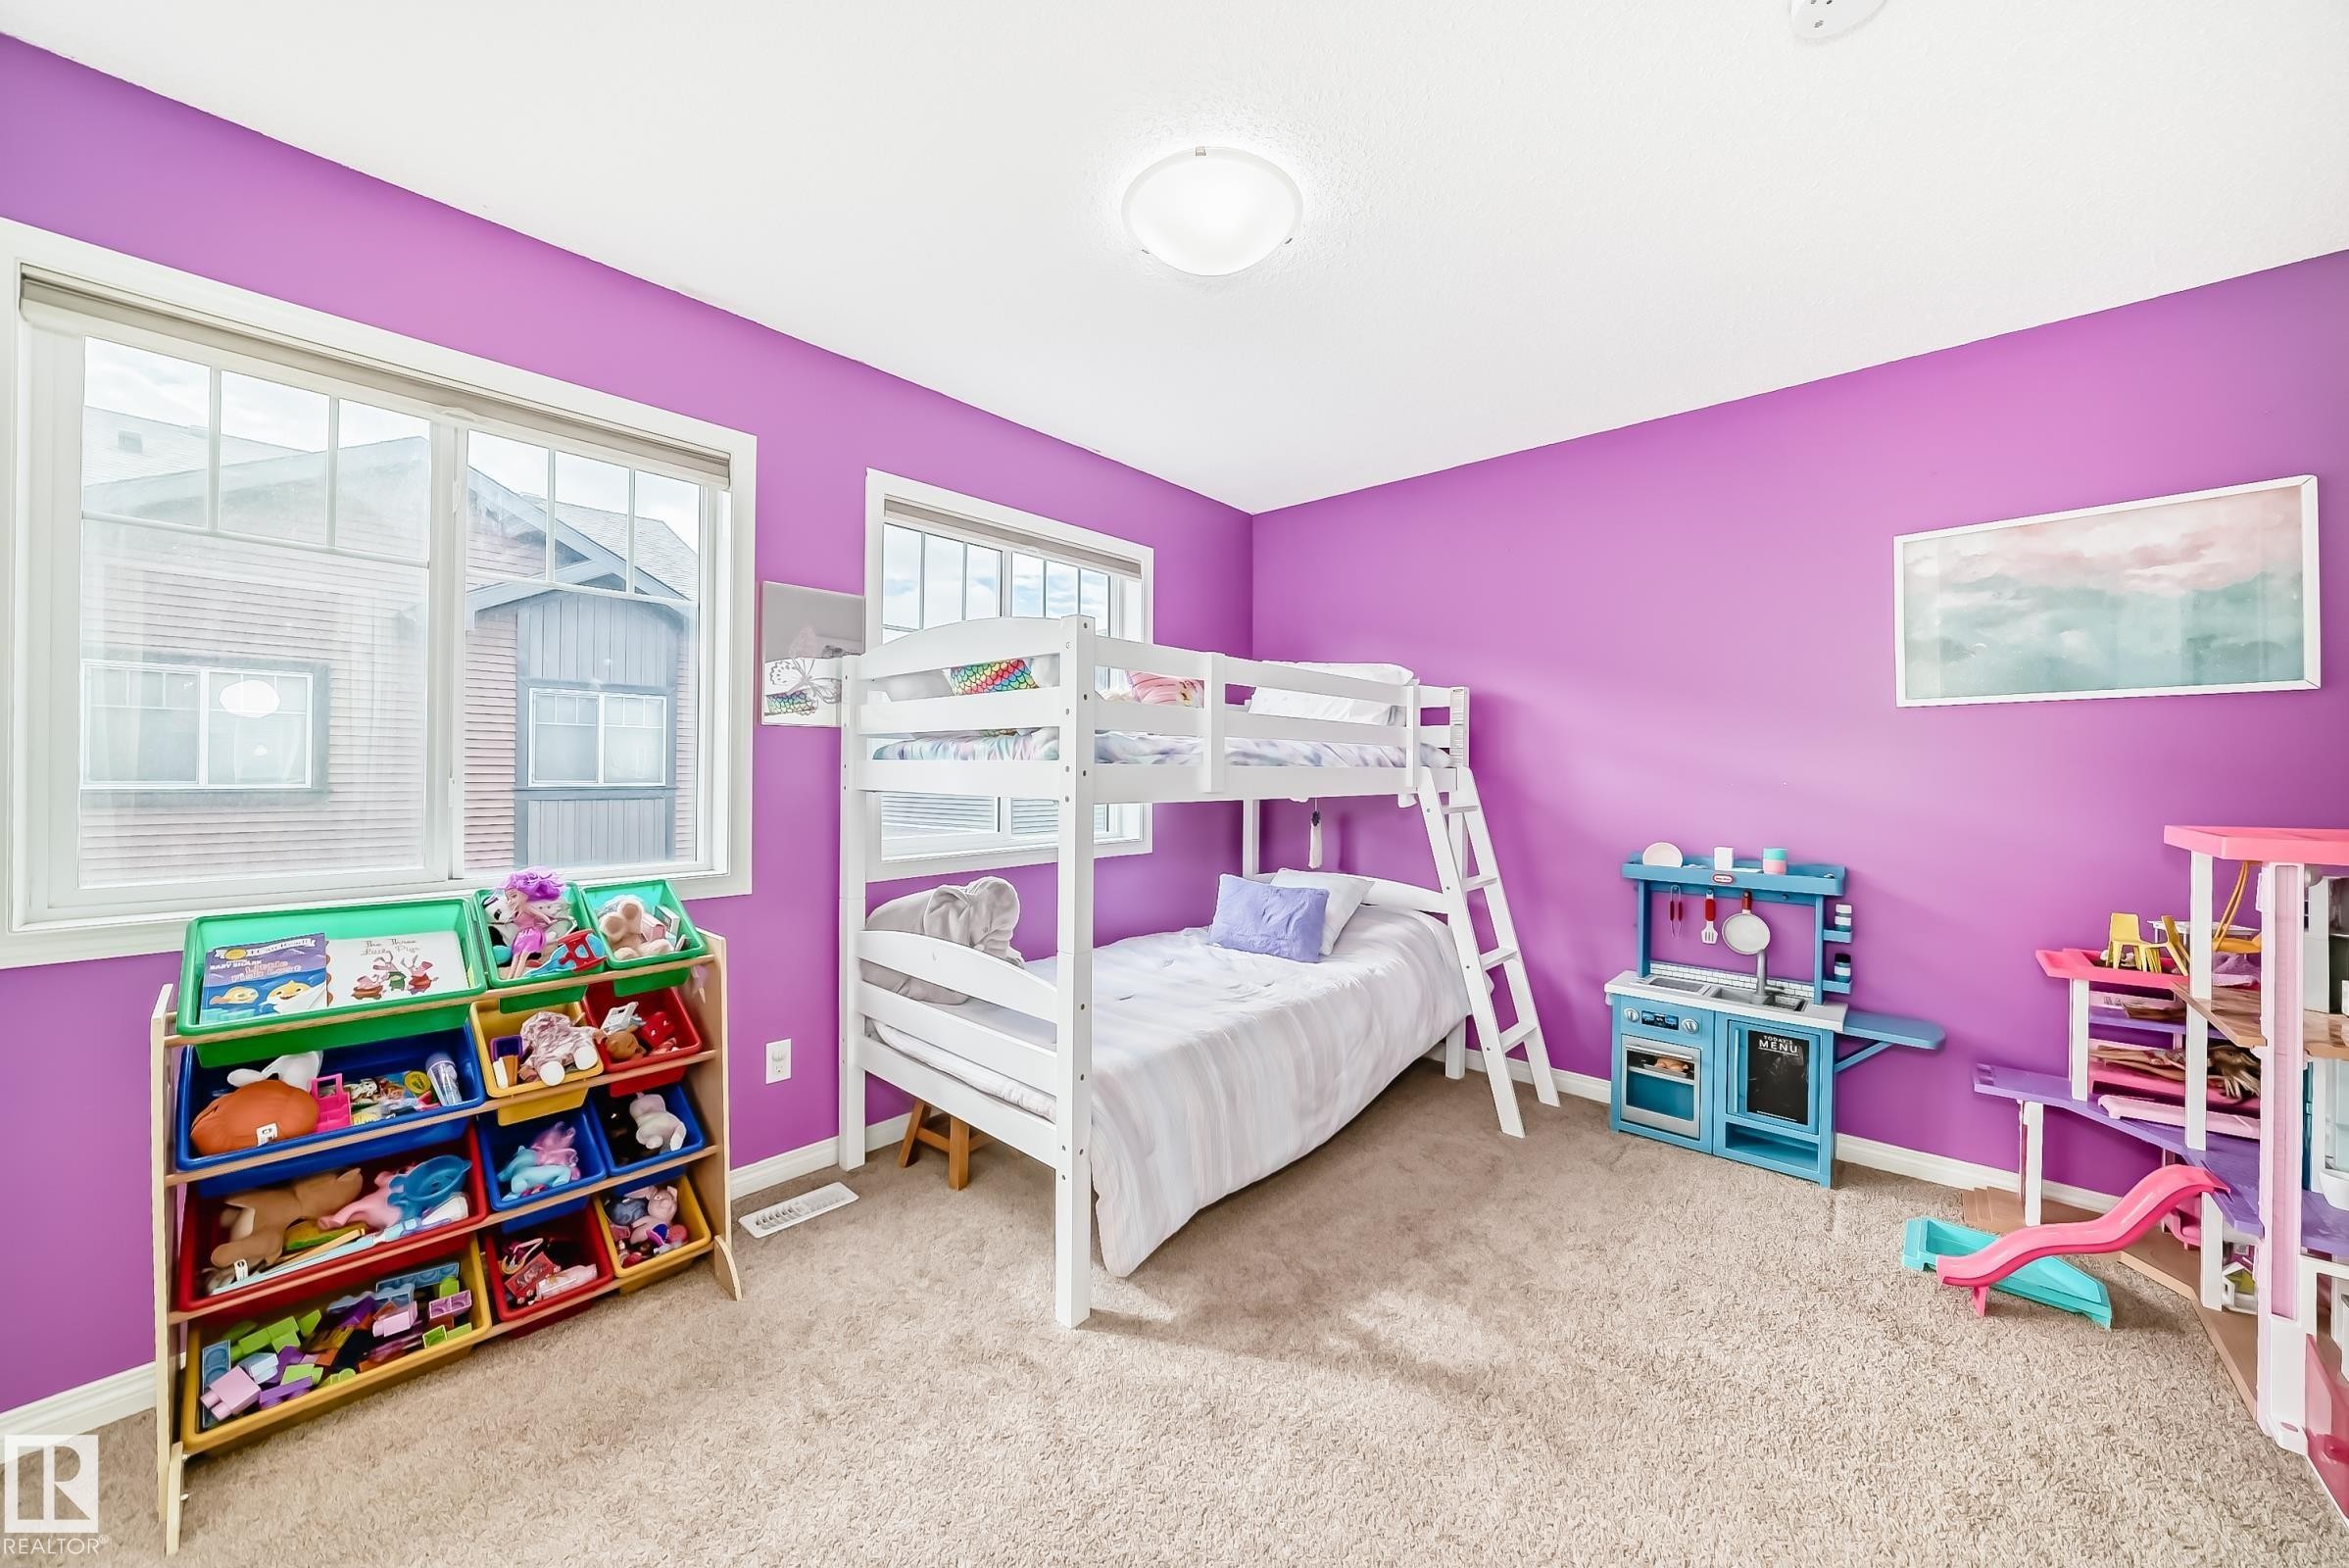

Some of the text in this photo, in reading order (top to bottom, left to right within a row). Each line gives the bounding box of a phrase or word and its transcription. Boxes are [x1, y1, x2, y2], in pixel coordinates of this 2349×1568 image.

[210, 961, 232, 970] BABY
[233, 959, 263, 968] SHARK
[1763, 1035, 1793, 1045] TODAY'S
[1758, 1039, 1798, 1054] MENU
